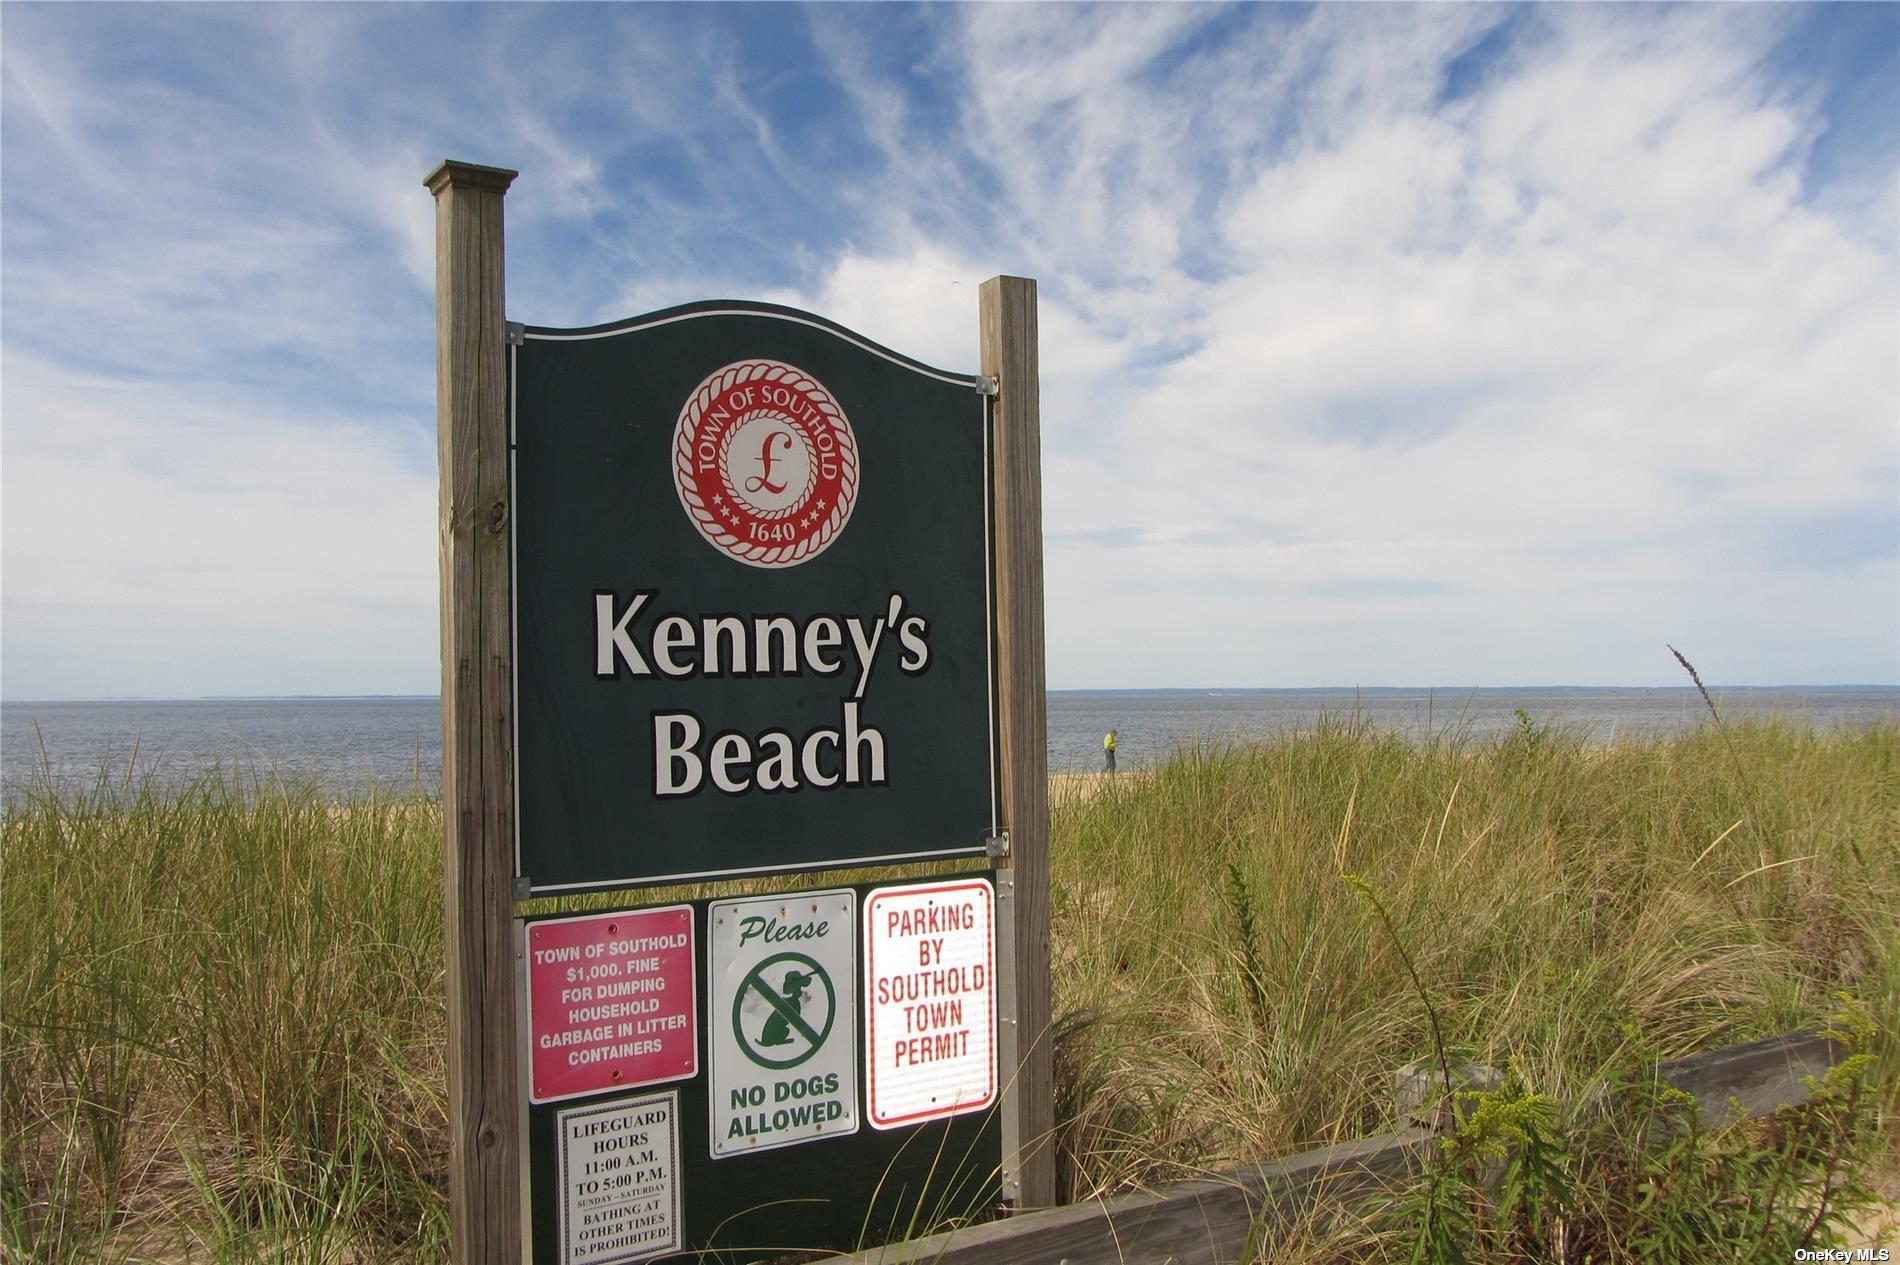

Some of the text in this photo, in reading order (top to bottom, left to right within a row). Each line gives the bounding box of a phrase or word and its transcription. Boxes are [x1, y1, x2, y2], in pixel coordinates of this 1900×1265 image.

[699, 386, 837, 480] TOWN OF SOUTHOLD
[749, 522, 795, 542] 1640
[596, 594, 928, 698] Kenney's
[654, 702, 884, 795] Beach
[739, 916, 829, 948] Please
[888, 902, 974, 938] PARKING
[535, 934, 687, 965] TOWN OF SOUTHOLD
[919, 938, 944, 966] BY
[567, 958, 659, 983] $1,000. FINE
[878, 964, 985, 1005] SOUTHOLD
[562, 977, 665, 1004] FOR DUMPING
[569, 999, 659, 1024] HOUSEHOLD
[904, 999, 963, 1034] TOWN
[540, 1015, 687, 1048] GARBAGE IN LITTER
[569, 1039, 662, 1065] CONTAINERS
[895, 1030, 970, 1068] PERMIT
[730, 1073, 839, 1110] NO DOGS
[573, 1110, 666, 1139] LIFEGUARD
[728, 1100, 842, 1138] ALLOWED
[594, 1133, 648, 1154] HOURS
[585, 1150, 658, 1175] 11:00 A.M.
[576, 1167, 666, 1196] TO 5:00 P.M.
[577, 1194, 612, 1208] SUNDAY
[620, 1183, 666, 1199] SATURDAY
[579, 1213, 665, 1241] OTHER TIMES
[584, 1200, 661, 1225] BATHING AT
[575, 1227, 670, 1257] IS PROHIBITED!
